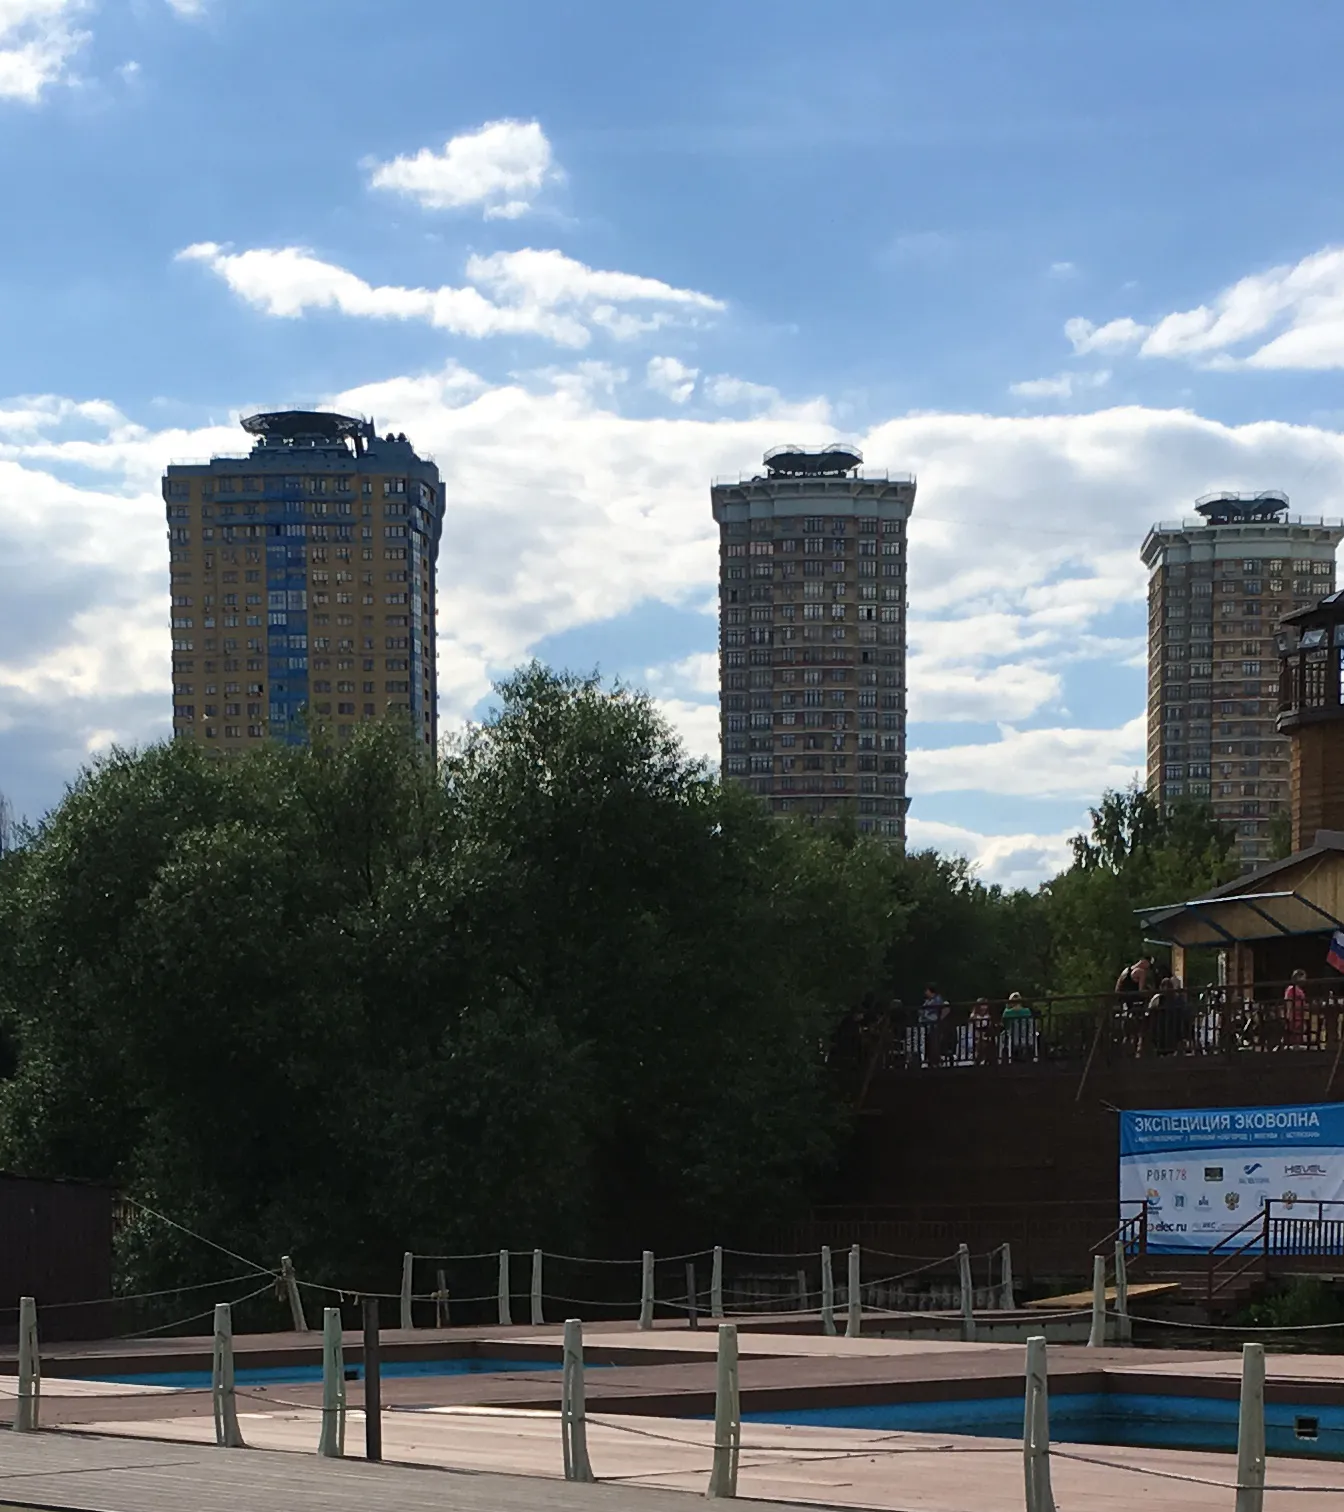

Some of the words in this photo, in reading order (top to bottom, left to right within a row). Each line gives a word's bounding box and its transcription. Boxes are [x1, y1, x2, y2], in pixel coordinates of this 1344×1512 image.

[1135, 1114, 1230, 1132] ЭКСПЕДИЦИЯ
[1235, 1111, 1320, 1129] ЭКОВОЛНА
[1146, 1168, 1187, 1182] PORT78
